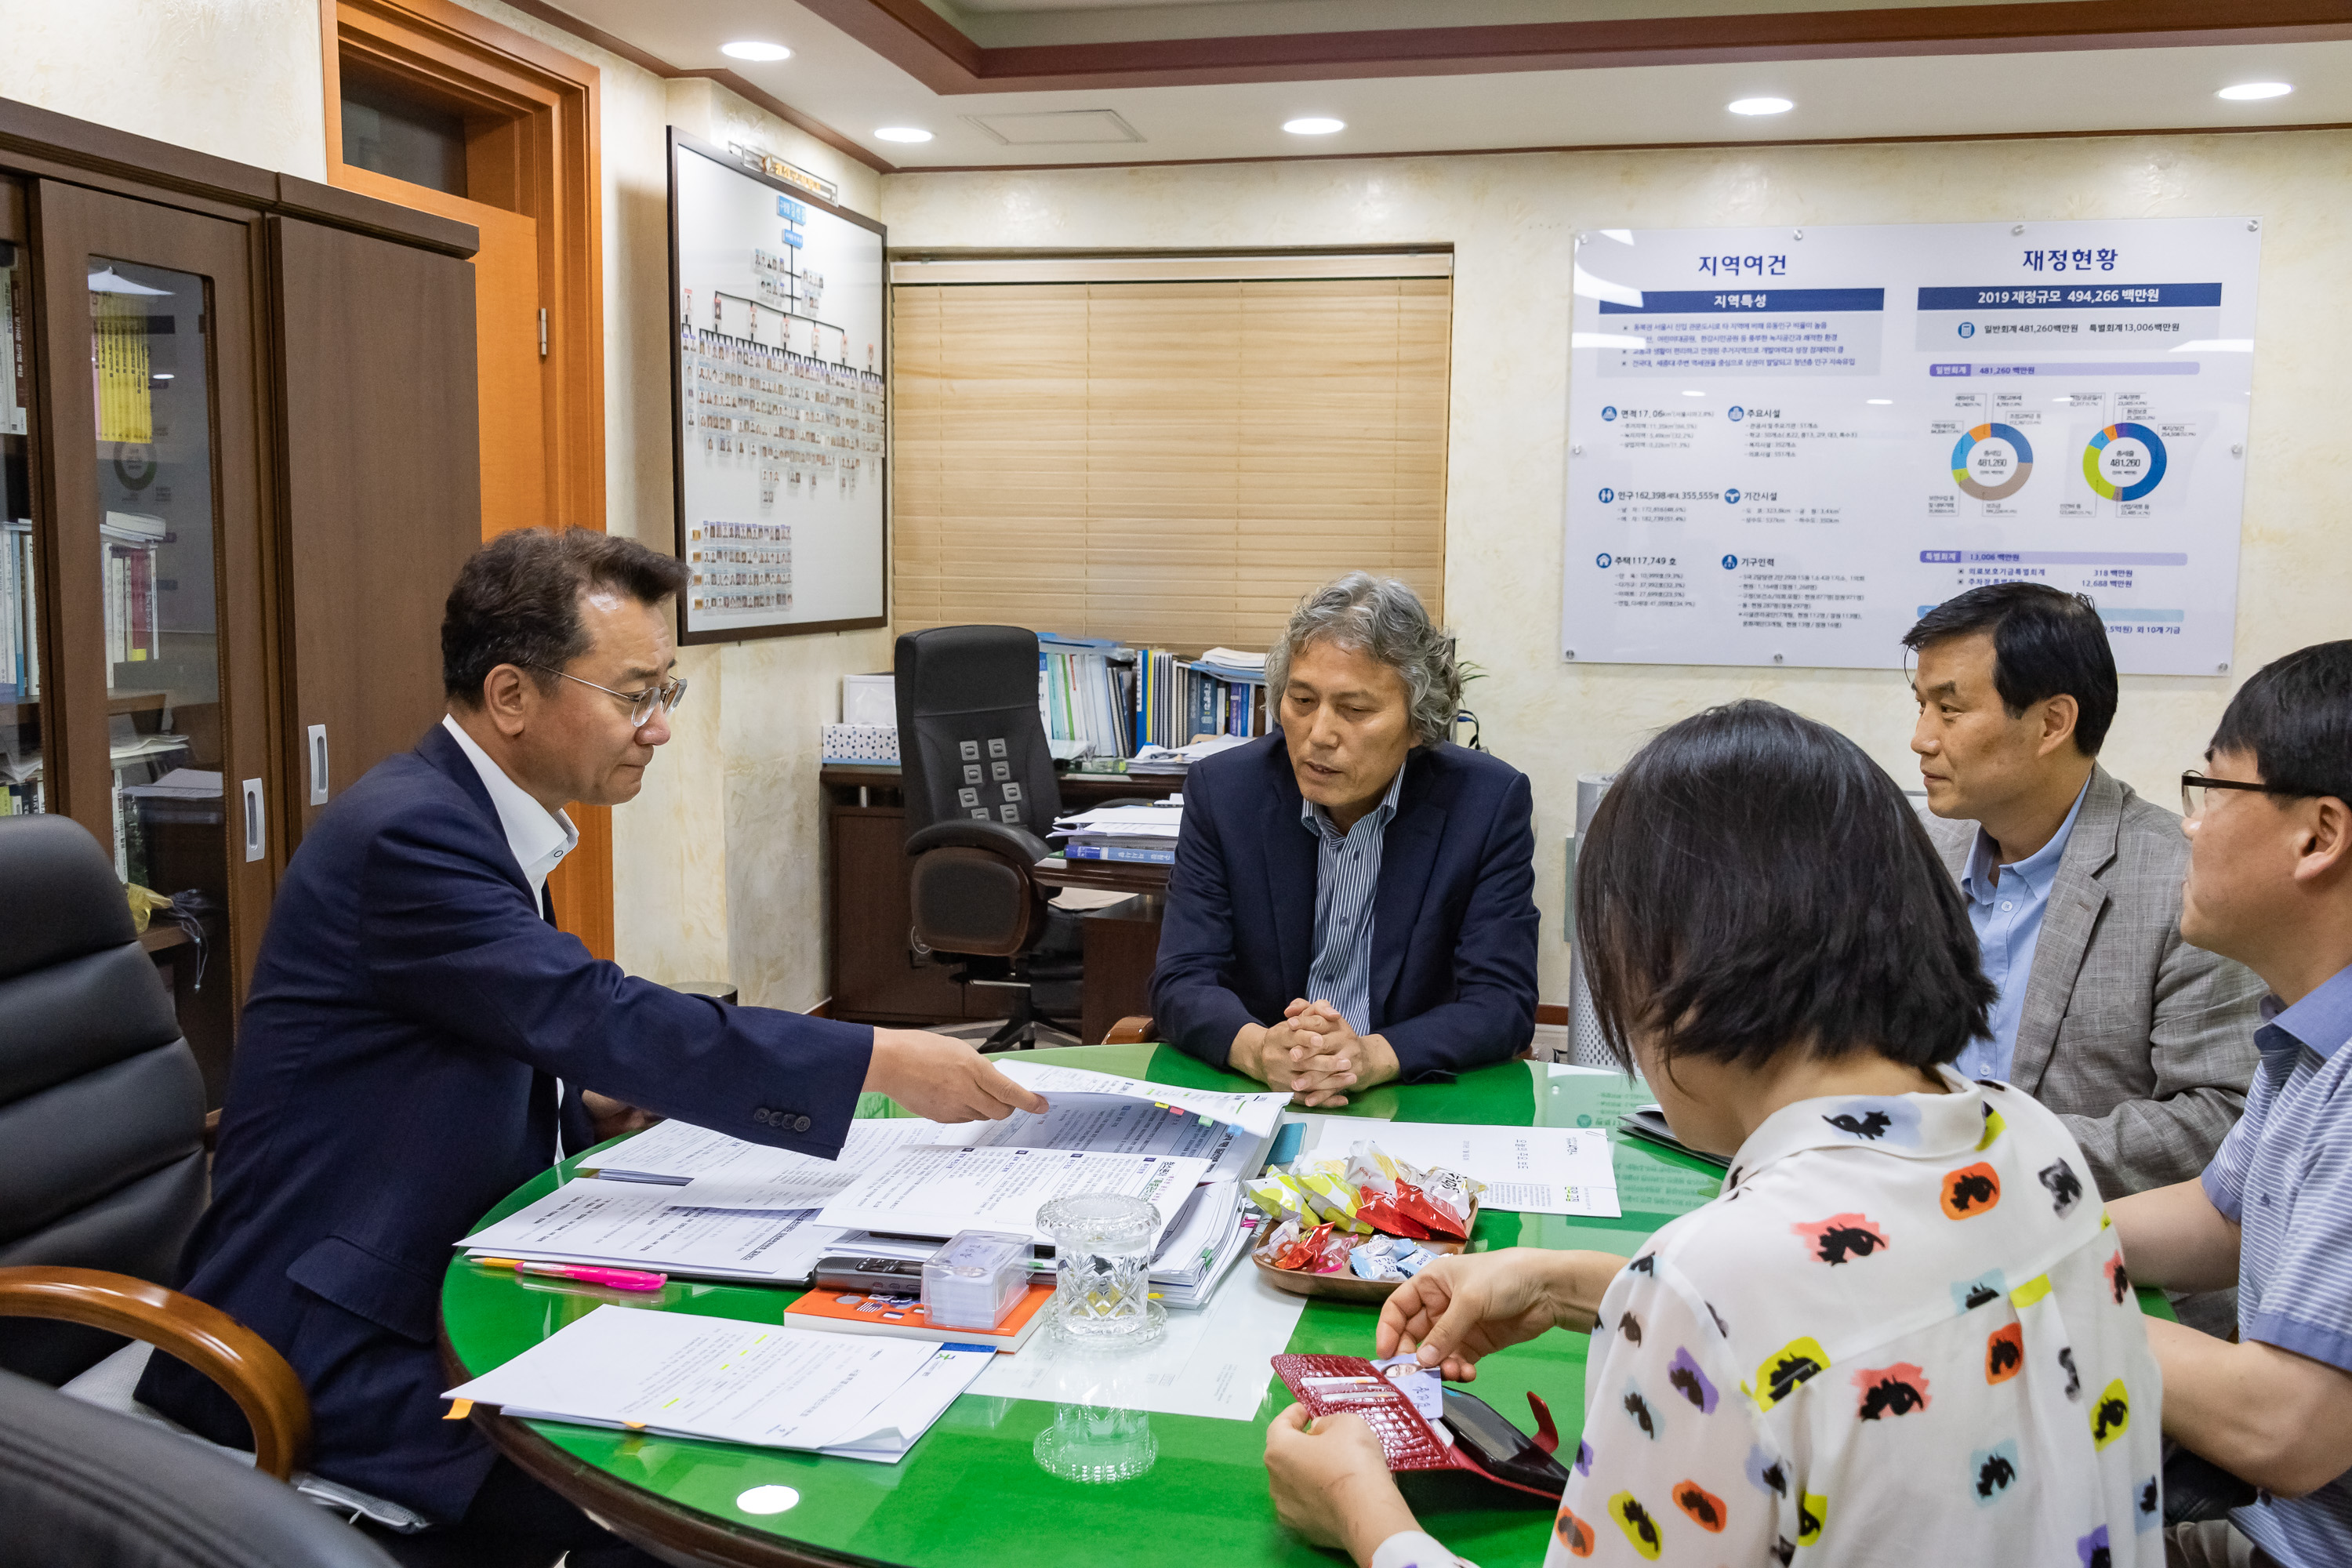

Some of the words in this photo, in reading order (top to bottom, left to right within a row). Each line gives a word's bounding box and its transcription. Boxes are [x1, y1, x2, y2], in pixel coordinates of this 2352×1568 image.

[2022, 248, 2118, 272] 재정현황
[1698, 255, 1787, 277] 지역여건
[1714, 294, 1767, 309] 지역특성
[1978, 291, 2009, 303] 2019
[2011, 290, 2061, 304] 재정규모
[2067, 290, 2119, 303] 494,266
[2122, 289, 2159, 303] 백만원
[1984, 325, 2017, 334] 일반회계
[1747, 409, 1780, 419] 주요시설
[1618, 491, 1634, 500] 인구
[1744, 492, 1777, 502] 기간시설
[1615, 557, 1631, 565] 주택
[2165, 626, 2181, 635] 기금
